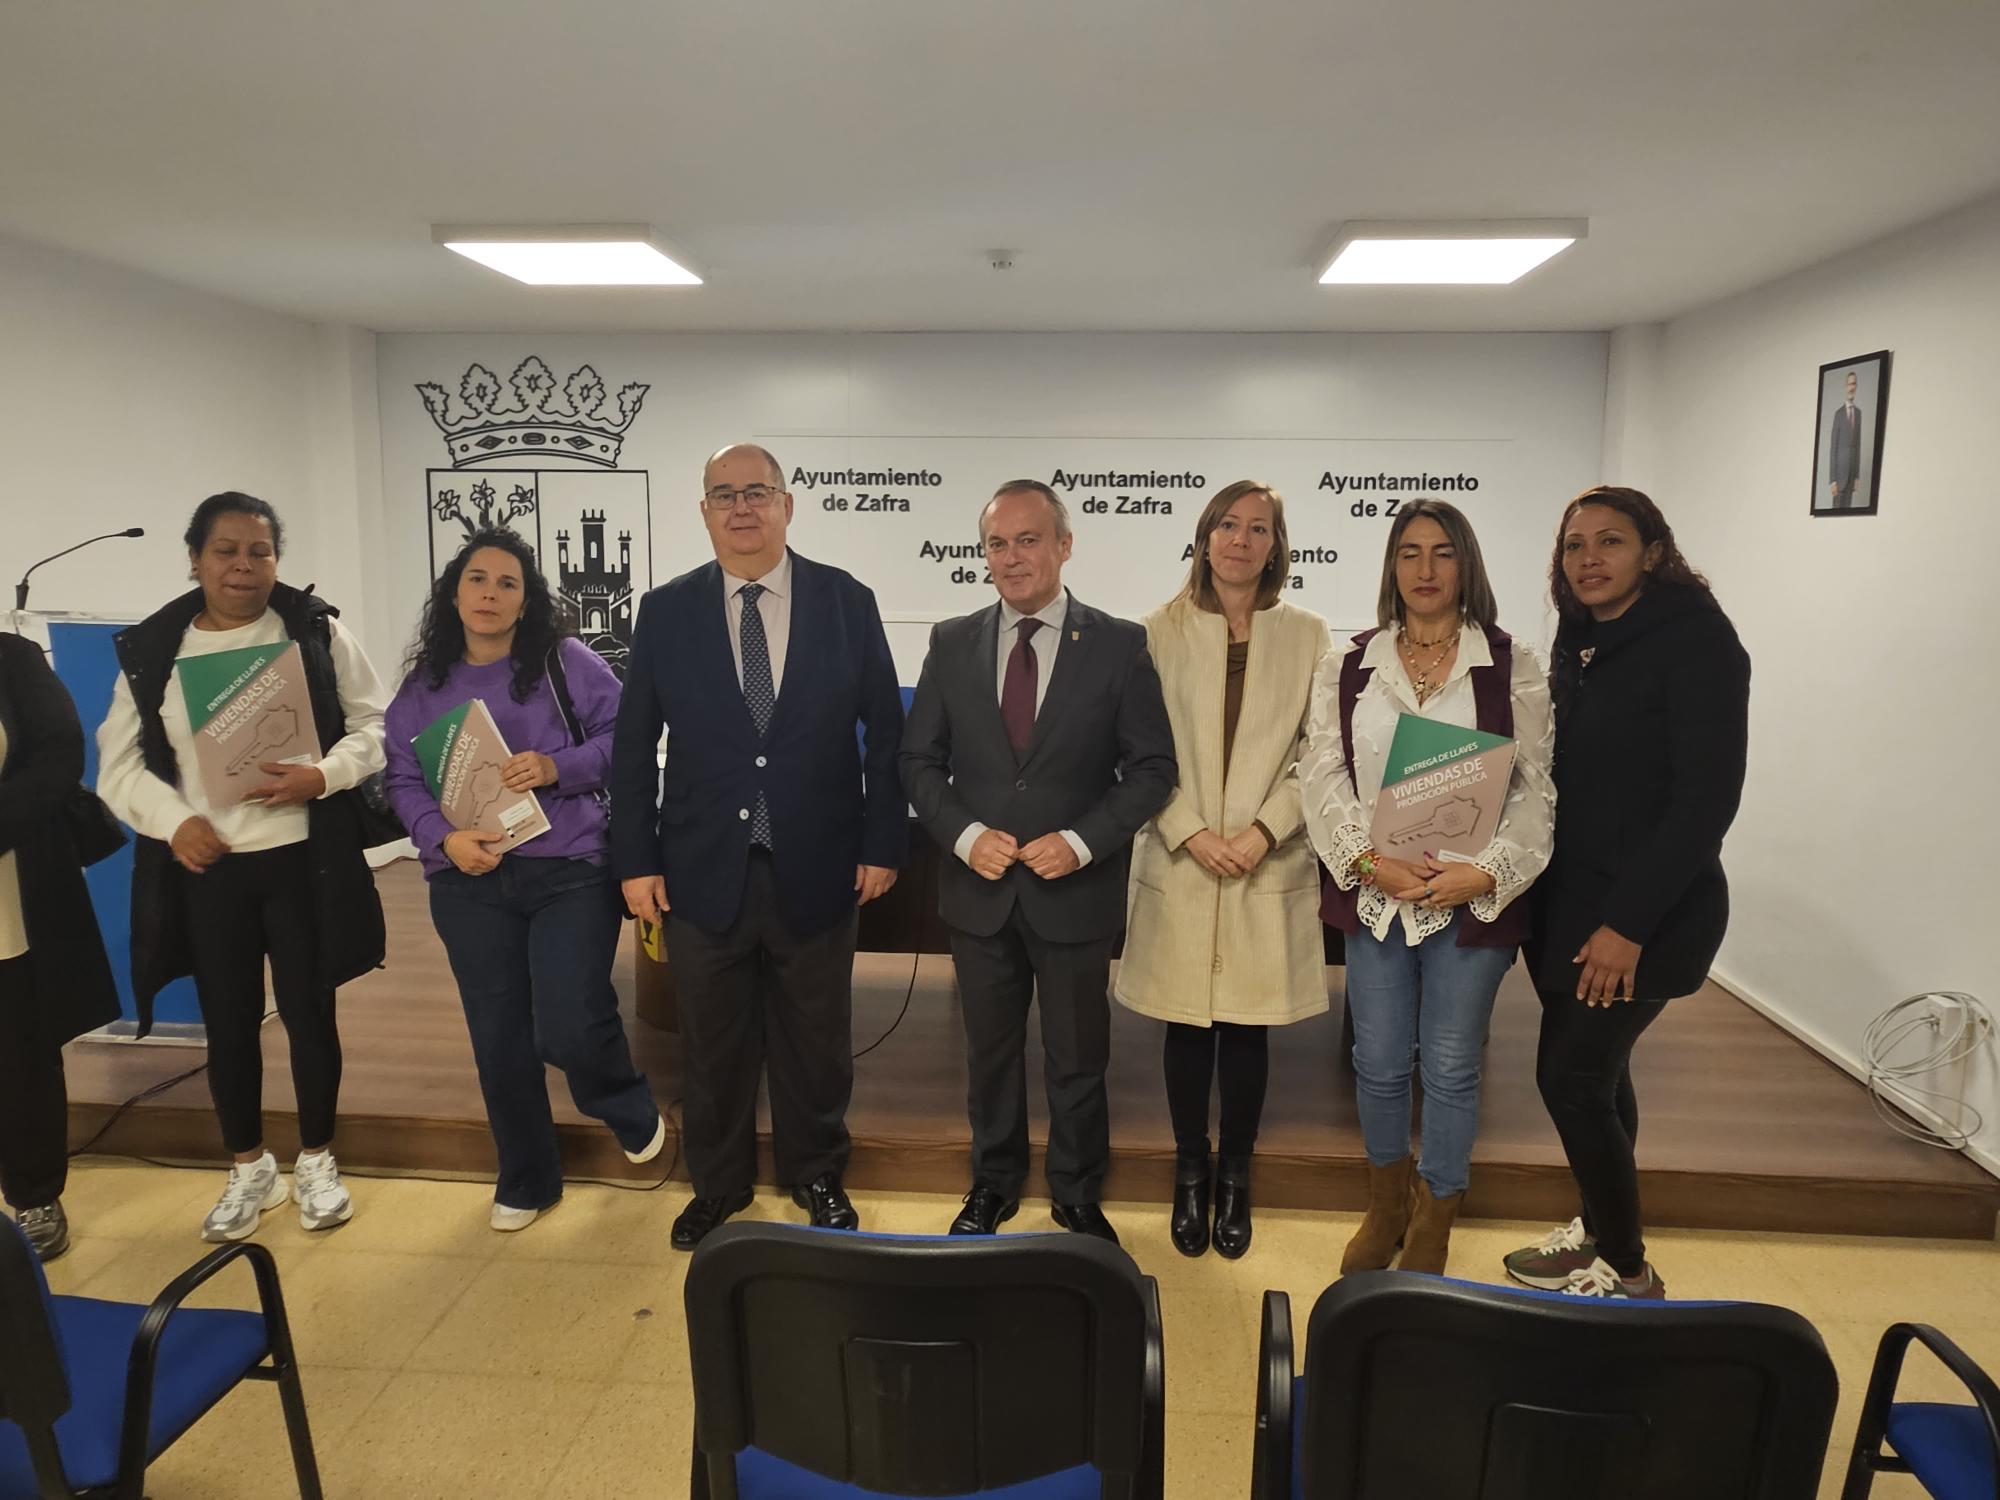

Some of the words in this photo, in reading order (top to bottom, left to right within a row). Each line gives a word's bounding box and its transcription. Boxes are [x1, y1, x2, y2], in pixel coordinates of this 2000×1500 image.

[791, 467, 942, 490] Ayuntamiento
[1050, 469, 1206, 491] Ayuntamiento
[1318, 471, 1479, 495] Ayuntamiento
[822, 493, 849, 511] de
[855, 493, 910, 512] Zafra
[1082, 496, 1109, 514] de
[1115, 496, 1173, 514] Zafra
[1350, 499, 1378, 517] de
[951, 566, 977, 584] de
[206, 684, 237, 712] ENTREGA
[234, 676, 245, 688] DE
[243, 656, 267, 679] LLAVES
[204, 684, 264, 738] VIVIENDAS
[260, 667, 280, 688] DE
[442, 749, 466, 806] VIVIENDAS
[460, 730, 473, 750] DE
[1403, 757, 1438, 775] ENTREGA
[1438, 752, 1450, 763] DE
[1449, 741, 1479, 759] LLAVES
[1392, 765, 1462, 799] VIVIENDAS
[1463, 757, 1484, 775] DE
